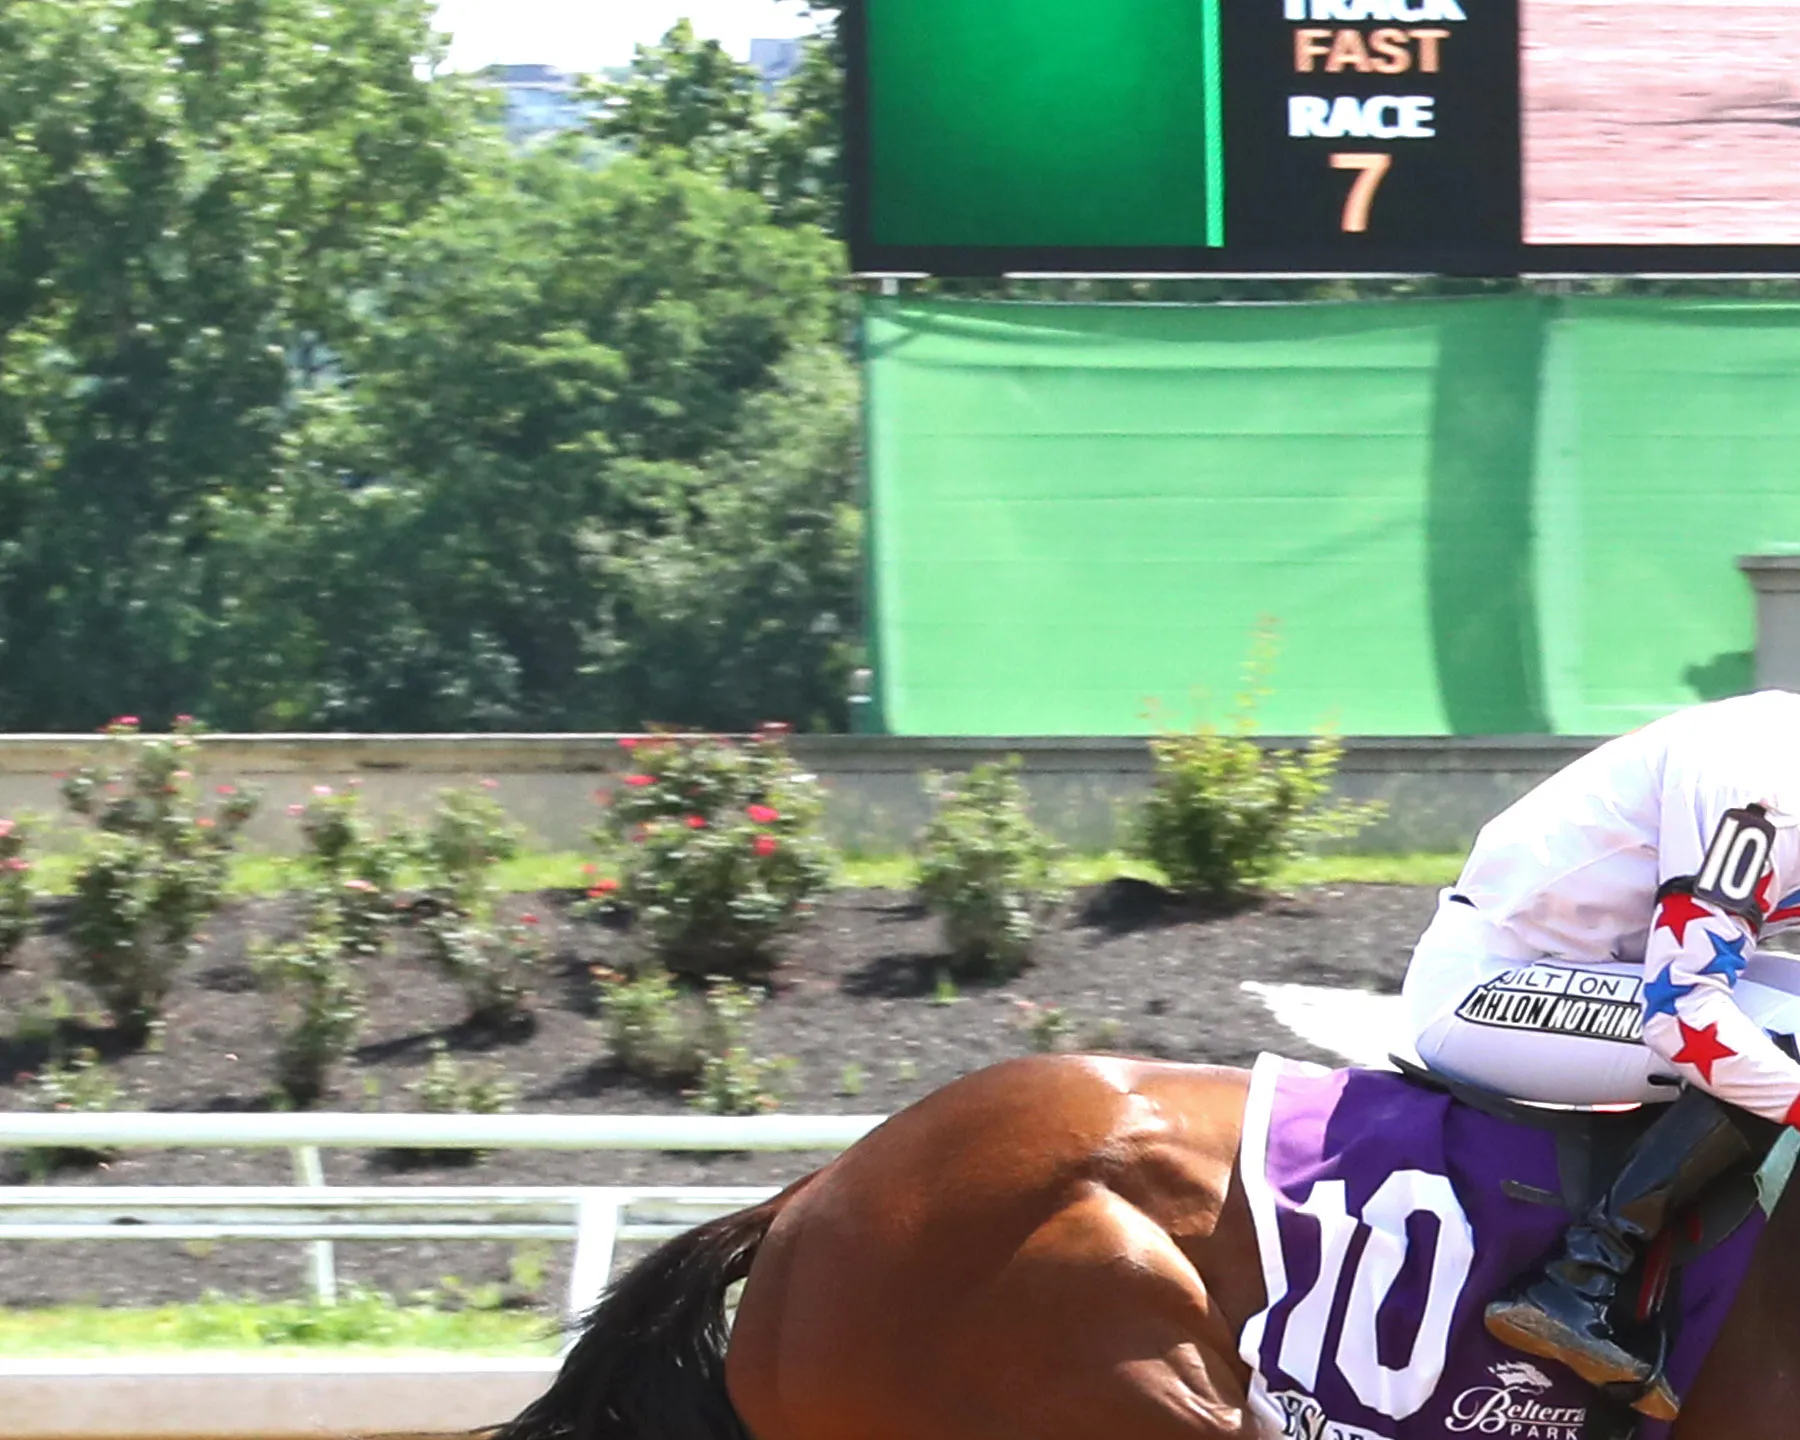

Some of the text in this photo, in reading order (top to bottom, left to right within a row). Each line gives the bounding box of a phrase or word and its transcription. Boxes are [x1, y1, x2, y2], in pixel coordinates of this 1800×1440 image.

[1293, 27, 1452, 74] FAST
[1287, 94, 1437, 139] RACE
[1327, 152, 1393, 233] 7
[1698, 816, 1769, 900] 10
[1579, 977, 1621, 996] ON
[1277, 1168, 1475, 1421] 10
[1444, 1385, 1586, 1434] Belterra
